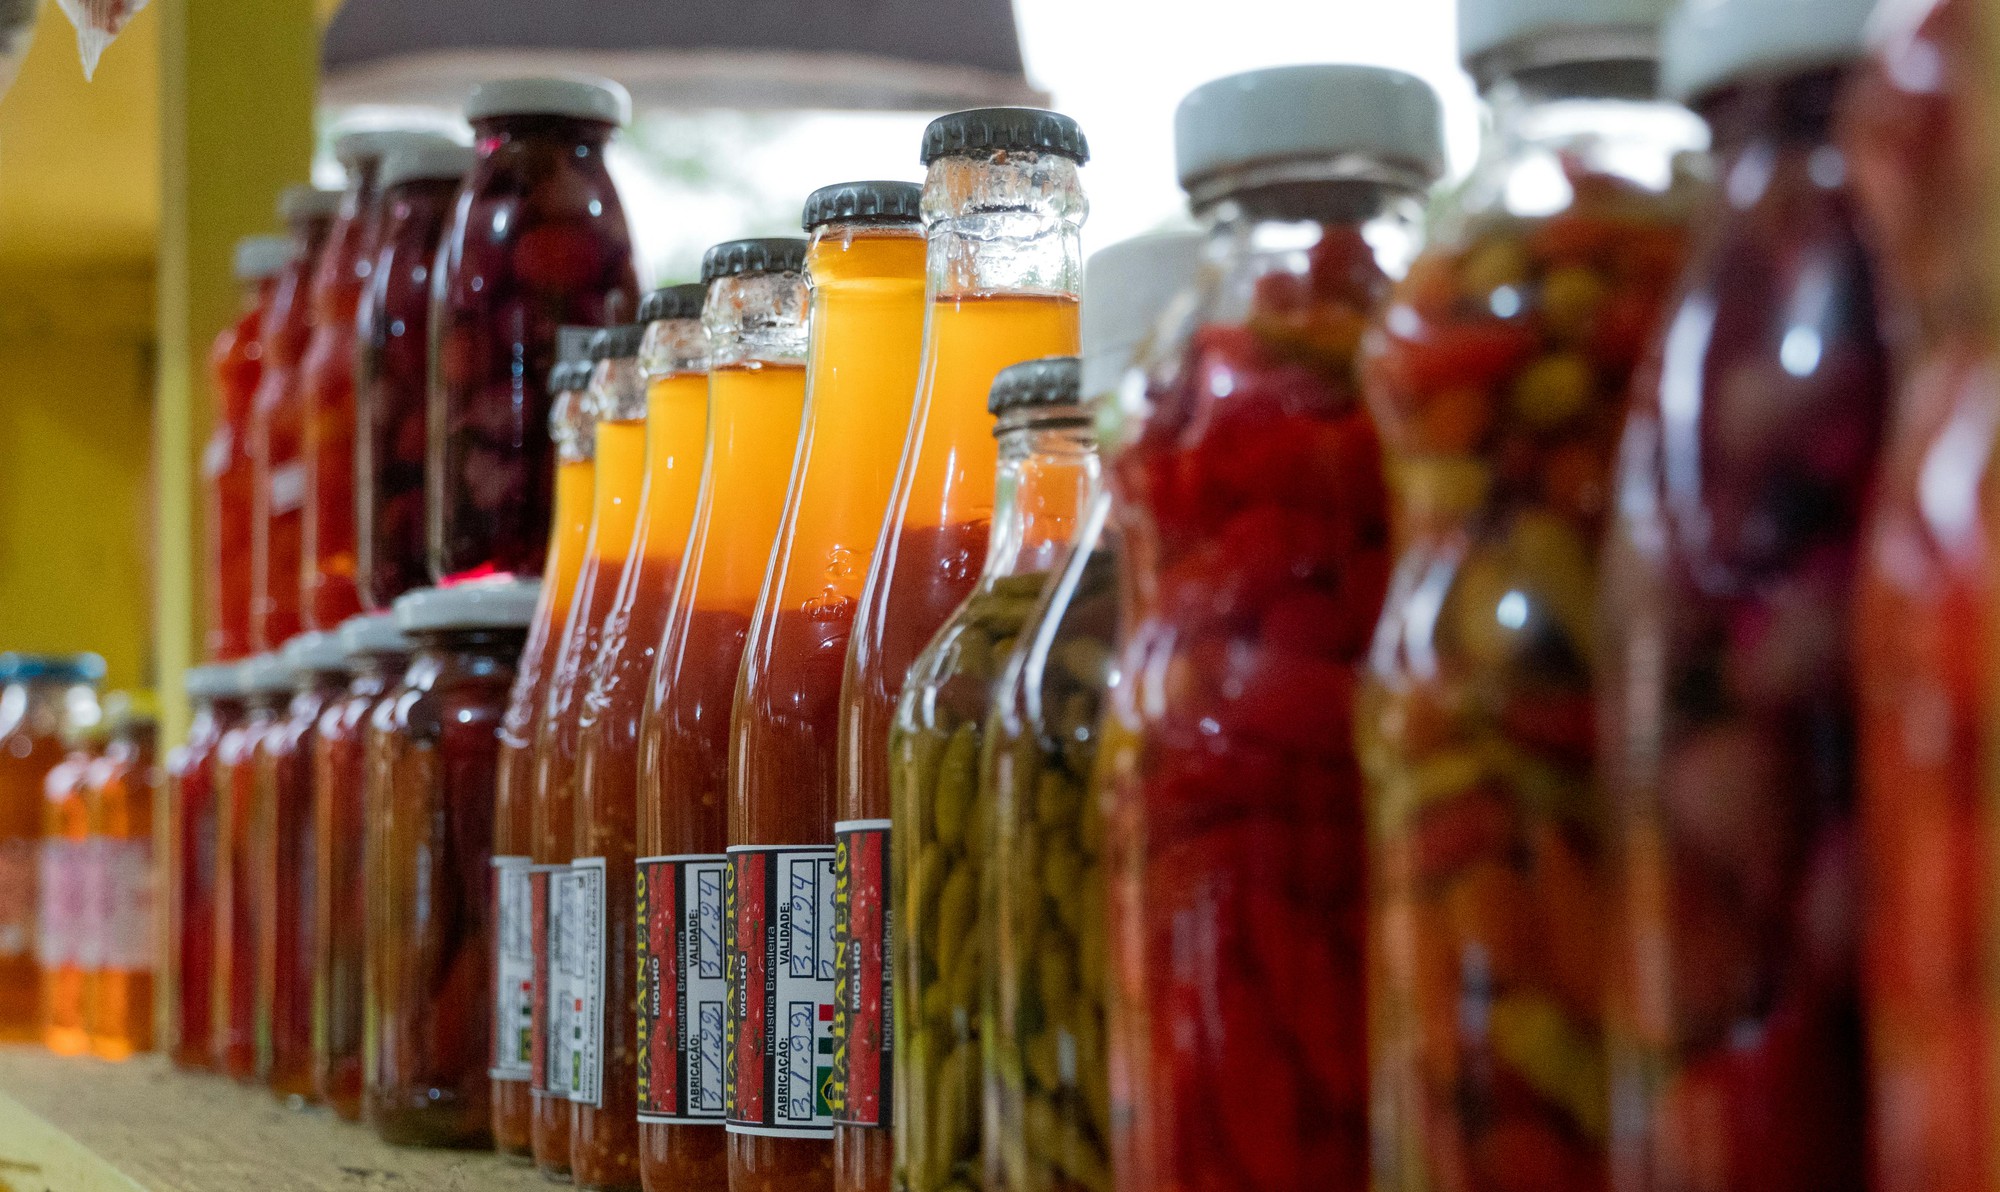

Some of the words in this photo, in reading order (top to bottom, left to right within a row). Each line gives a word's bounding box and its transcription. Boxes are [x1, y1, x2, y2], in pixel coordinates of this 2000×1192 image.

[677, 930, 685, 994] Brasileira
[689, 908, 699, 968] VALIDADE:
[766, 925, 775, 992] Brasileira
[779, 902, 790, 966] VALIDADE:
[637, 870, 648, 1104] HABANERO
[652, 959, 660, 1017] MOLHO
[726, 861, 735, 1110] HABANERO
[739, 953, 747, 1018] MOLHO
[834, 841, 848, 1111] HABANERO
[852, 941, 862, 1010] MOLHO
[765, 993, 776, 1056] Indústria
[777, 1037, 790, 1119] FABRICAÇÃO:
